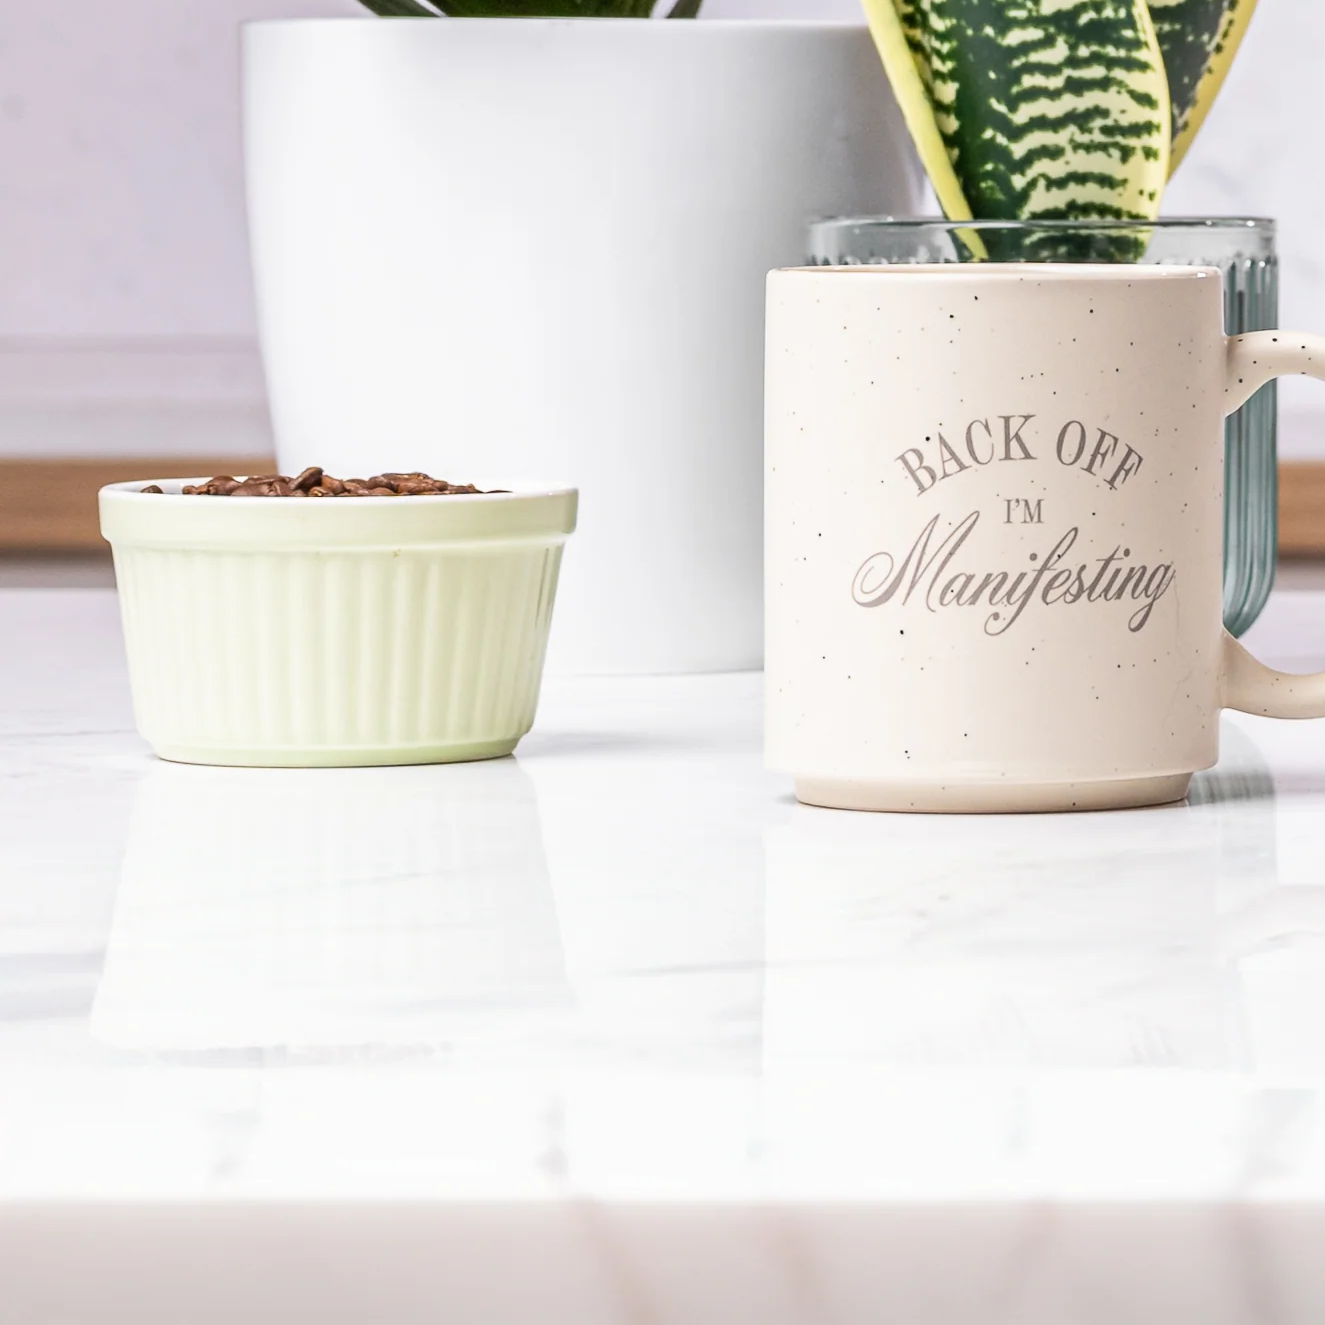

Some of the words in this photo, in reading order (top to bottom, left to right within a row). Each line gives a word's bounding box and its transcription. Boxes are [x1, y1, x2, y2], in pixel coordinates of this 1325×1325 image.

[896, 414, 1038, 496] BACK
[1056, 420, 1144, 491] OFF
[1004, 498, 1045, 524] I'M
[851, 510, 1178, 636] Manifesting
